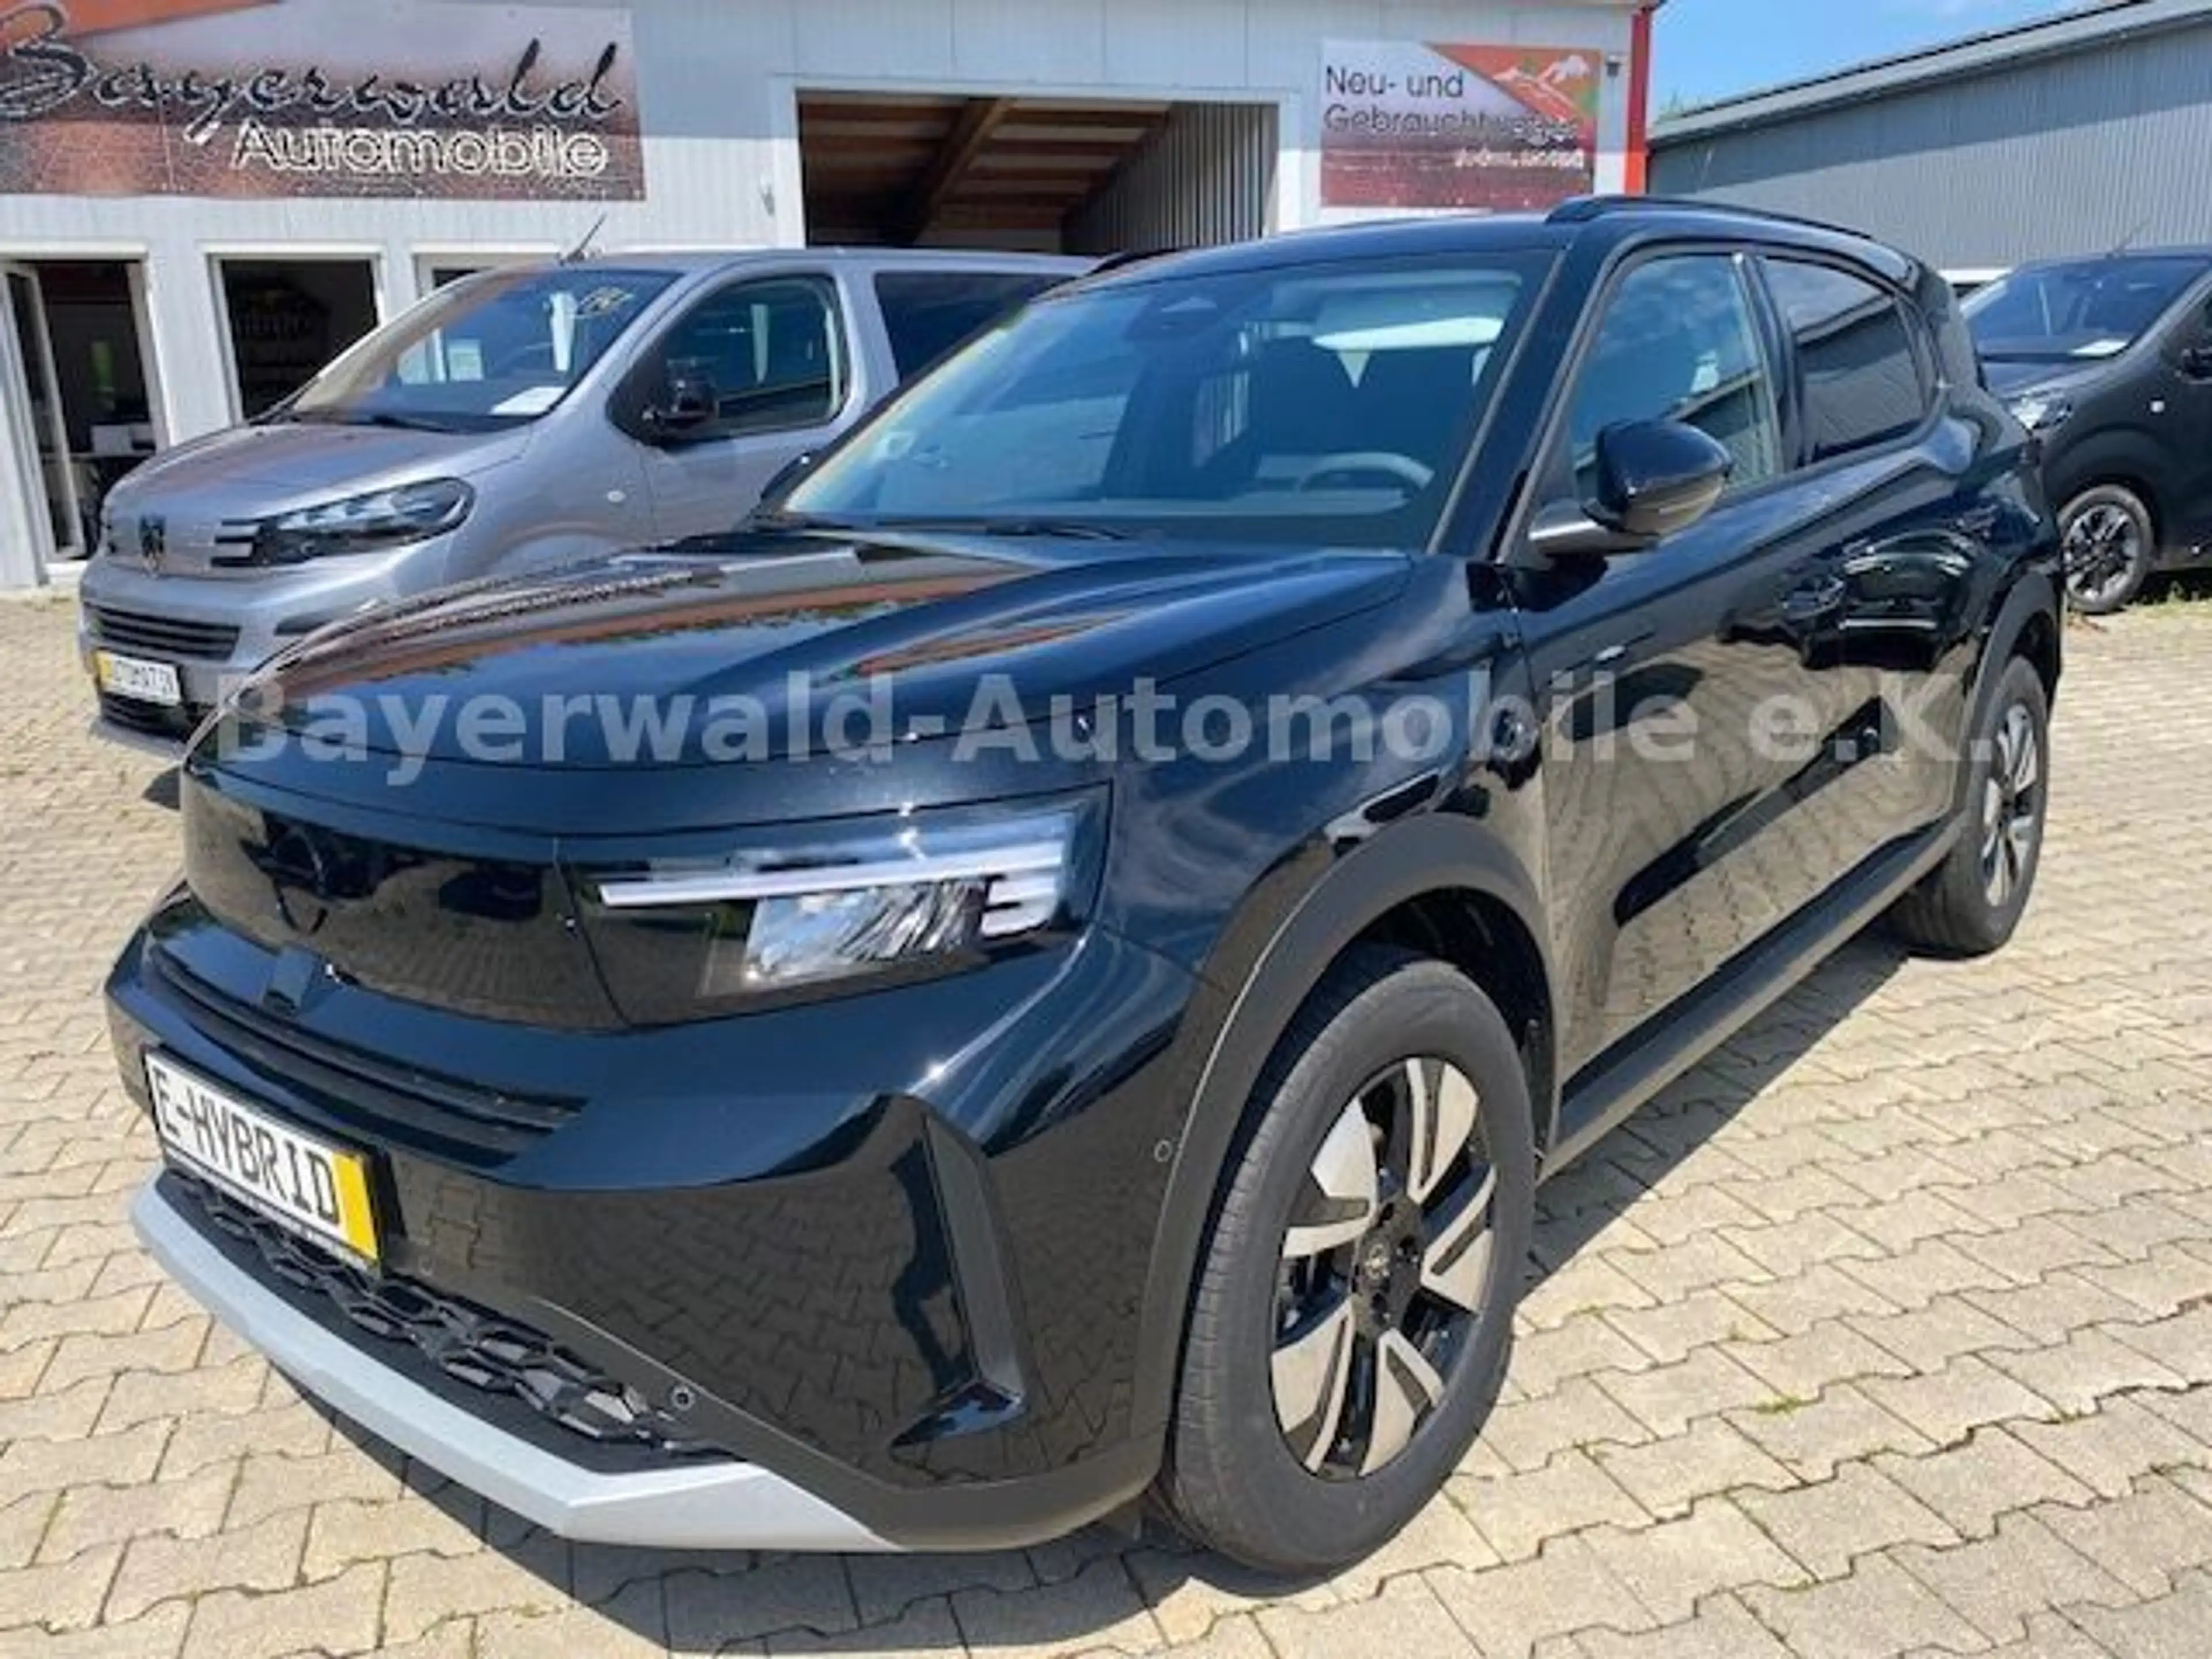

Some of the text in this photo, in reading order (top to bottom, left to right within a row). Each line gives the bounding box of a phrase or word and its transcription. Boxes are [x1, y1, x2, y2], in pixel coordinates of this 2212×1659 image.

[1325, 65, 1464, 99] Neu- und
[231, 119, 609, 178] Automobile
[152, 1066, 340, 1225] E-HYBRID
